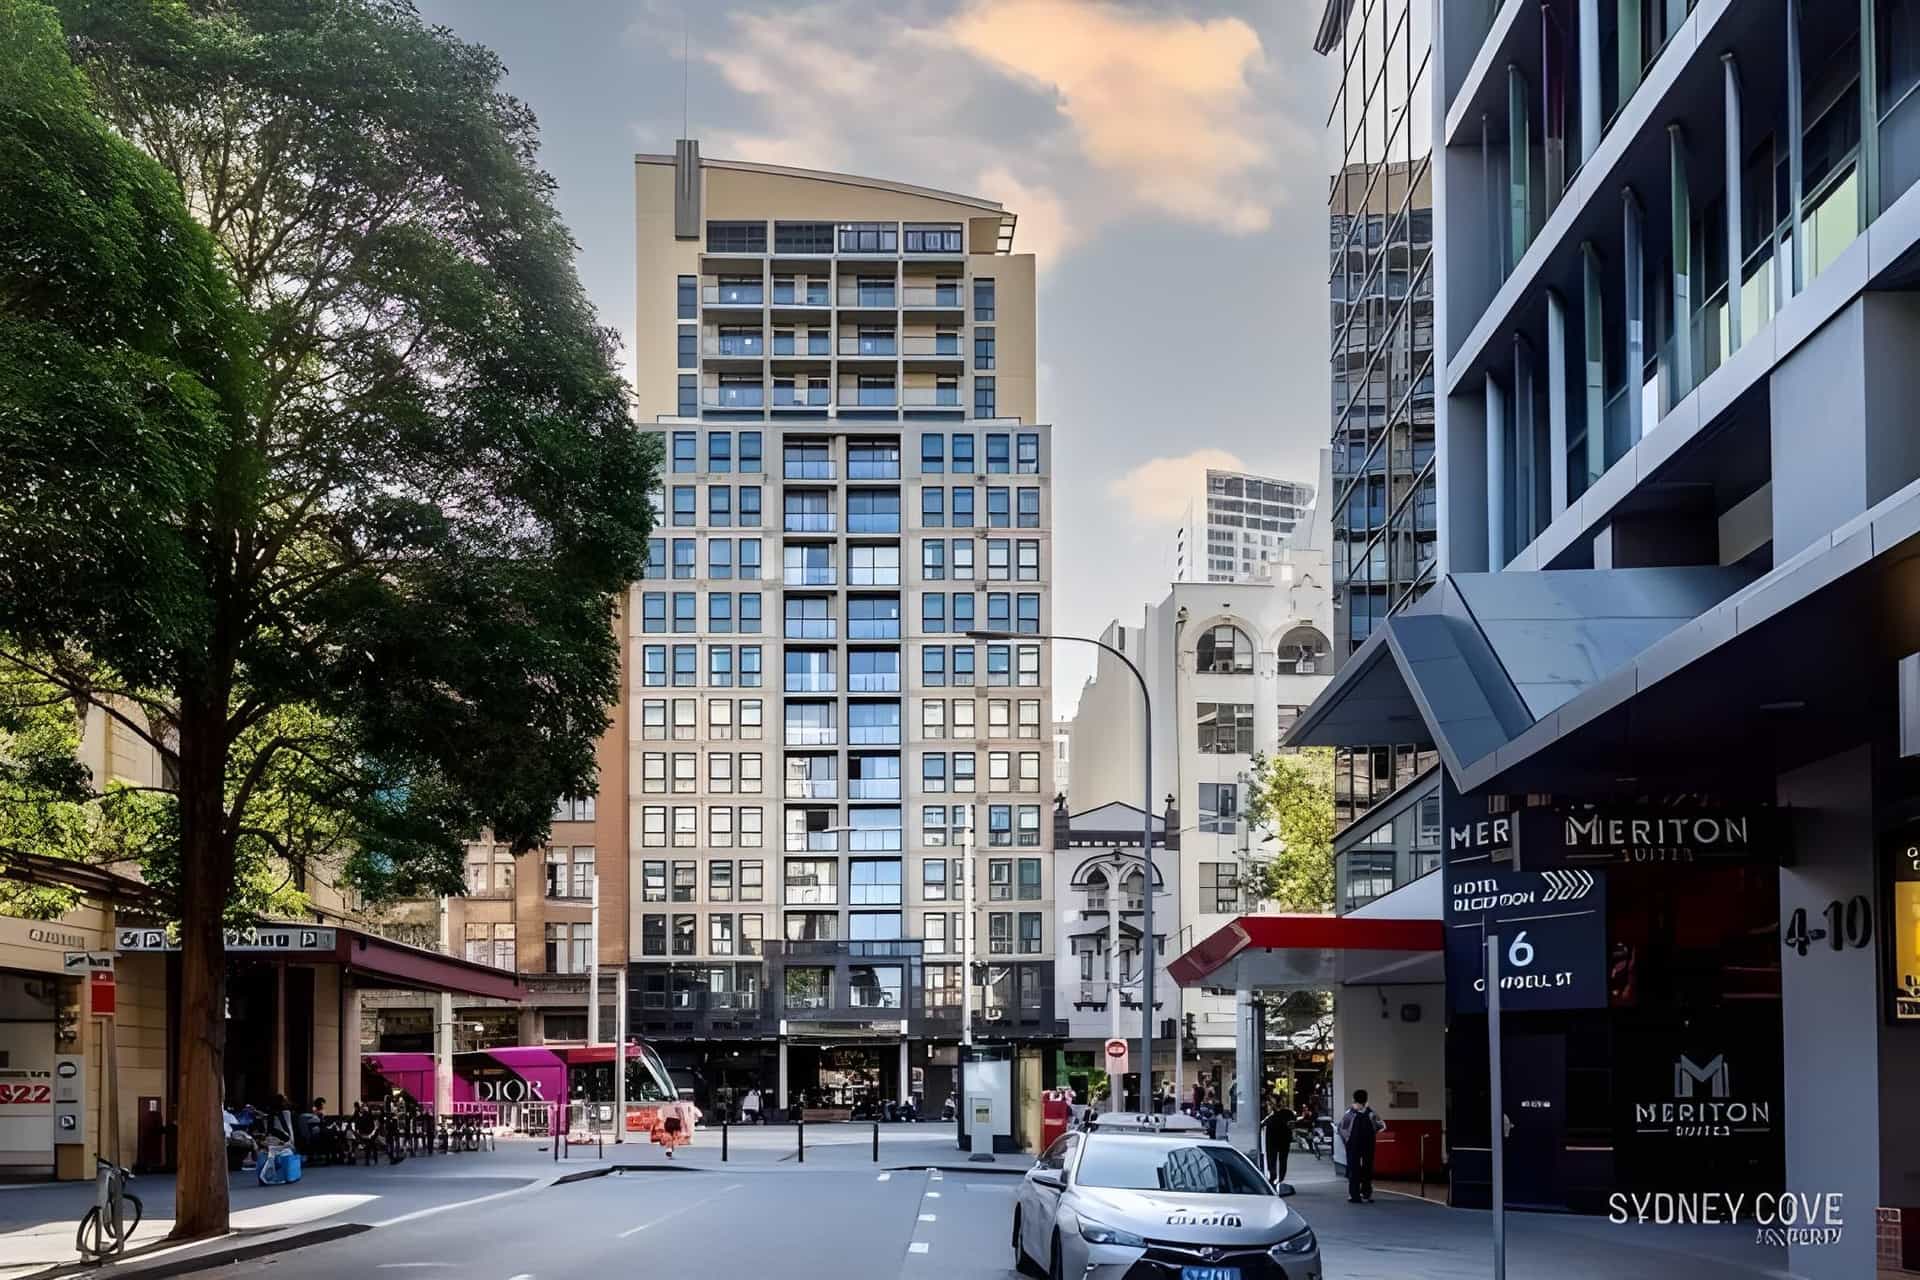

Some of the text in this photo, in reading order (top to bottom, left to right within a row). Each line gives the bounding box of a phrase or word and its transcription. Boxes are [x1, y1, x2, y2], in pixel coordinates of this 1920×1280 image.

[1565, 814, 1748, 846] MERITON
[1508, 930, 1535, 967] 6
[474, 1078, 546, 1102] DIOR
[1635, 1101, 1769, 1123] MERITON
